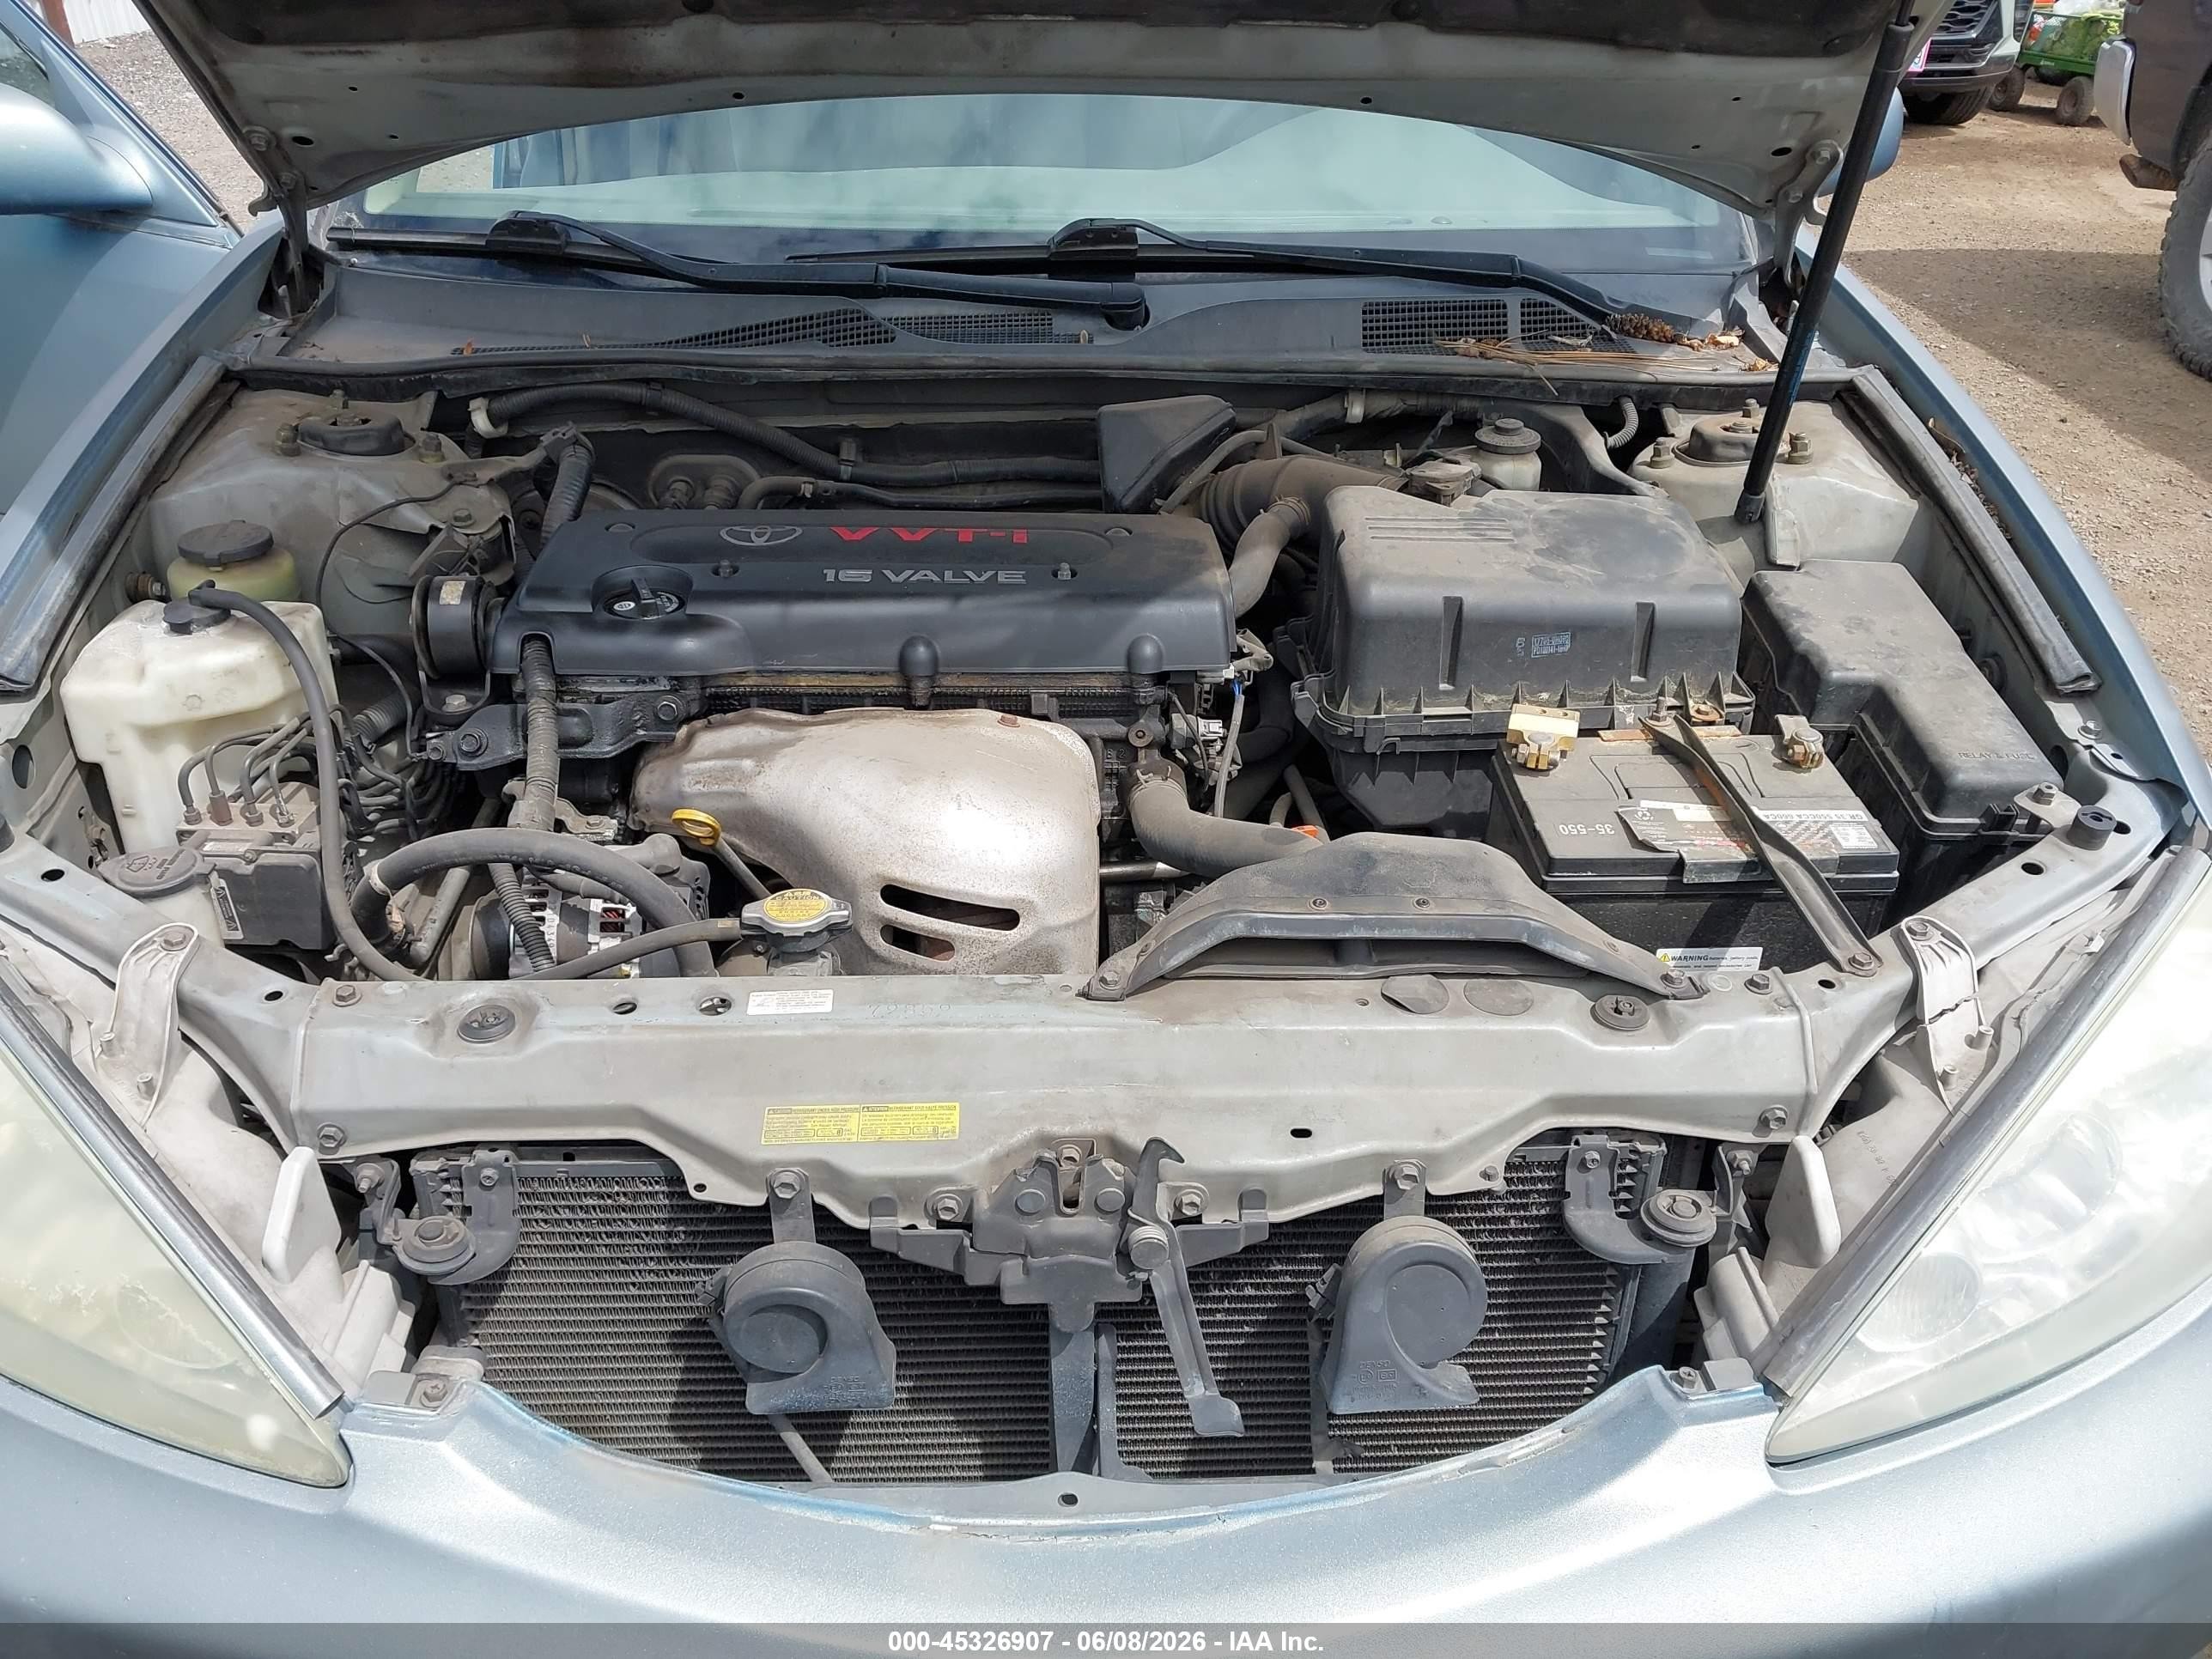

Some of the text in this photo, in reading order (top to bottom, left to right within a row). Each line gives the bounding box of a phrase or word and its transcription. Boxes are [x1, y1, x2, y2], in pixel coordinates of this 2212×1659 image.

[823, 568, 1028, 585] 16 VALVE
[1559, 823, 1615, 836] 35-550
[1670, 954, 1710, 963] WARNING
